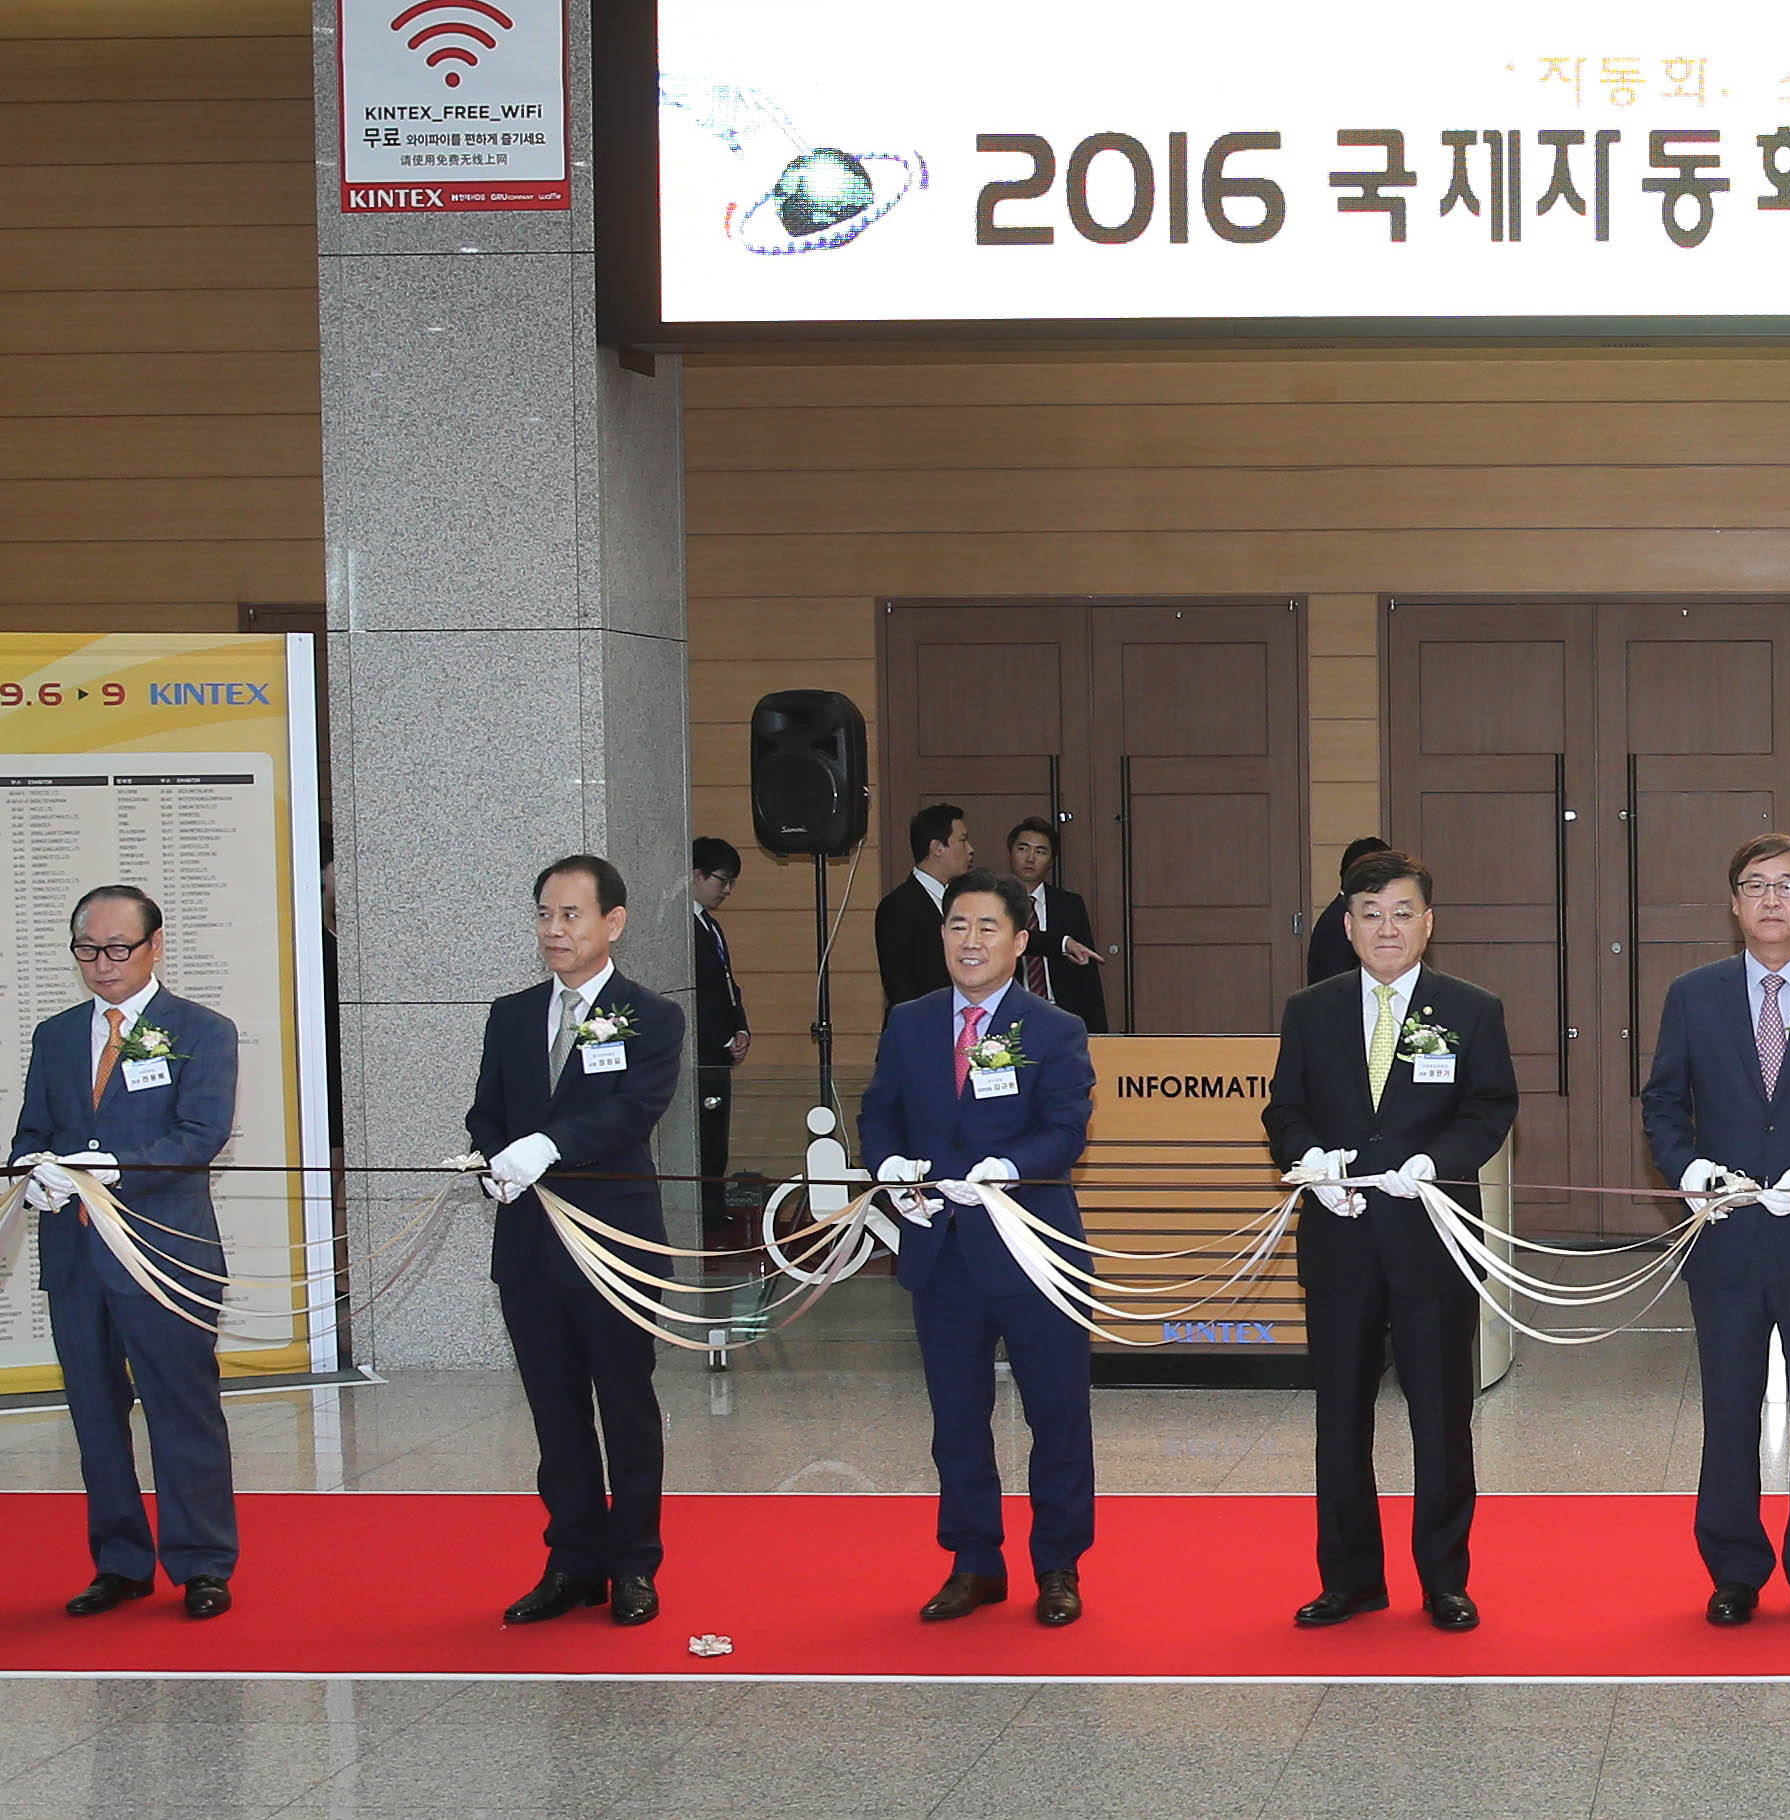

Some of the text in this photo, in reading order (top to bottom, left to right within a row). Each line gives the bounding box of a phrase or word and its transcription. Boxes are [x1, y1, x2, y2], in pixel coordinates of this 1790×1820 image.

[364, 104, 543, 122] KINTEX_FREE_WiFi
[362, 127, 547, 149] 무료 와이파이를 편하게 즐기세요
[349, 188, 445, 209] KINTEX
[975, 131, 1286, 245] 2016
[0, 682, 272, 706] 9.6 9 KINTEX
[1117, 1075, 1274, 1099] INFORMATI
[1162, 1321, 1277, 1344] KINTEX
